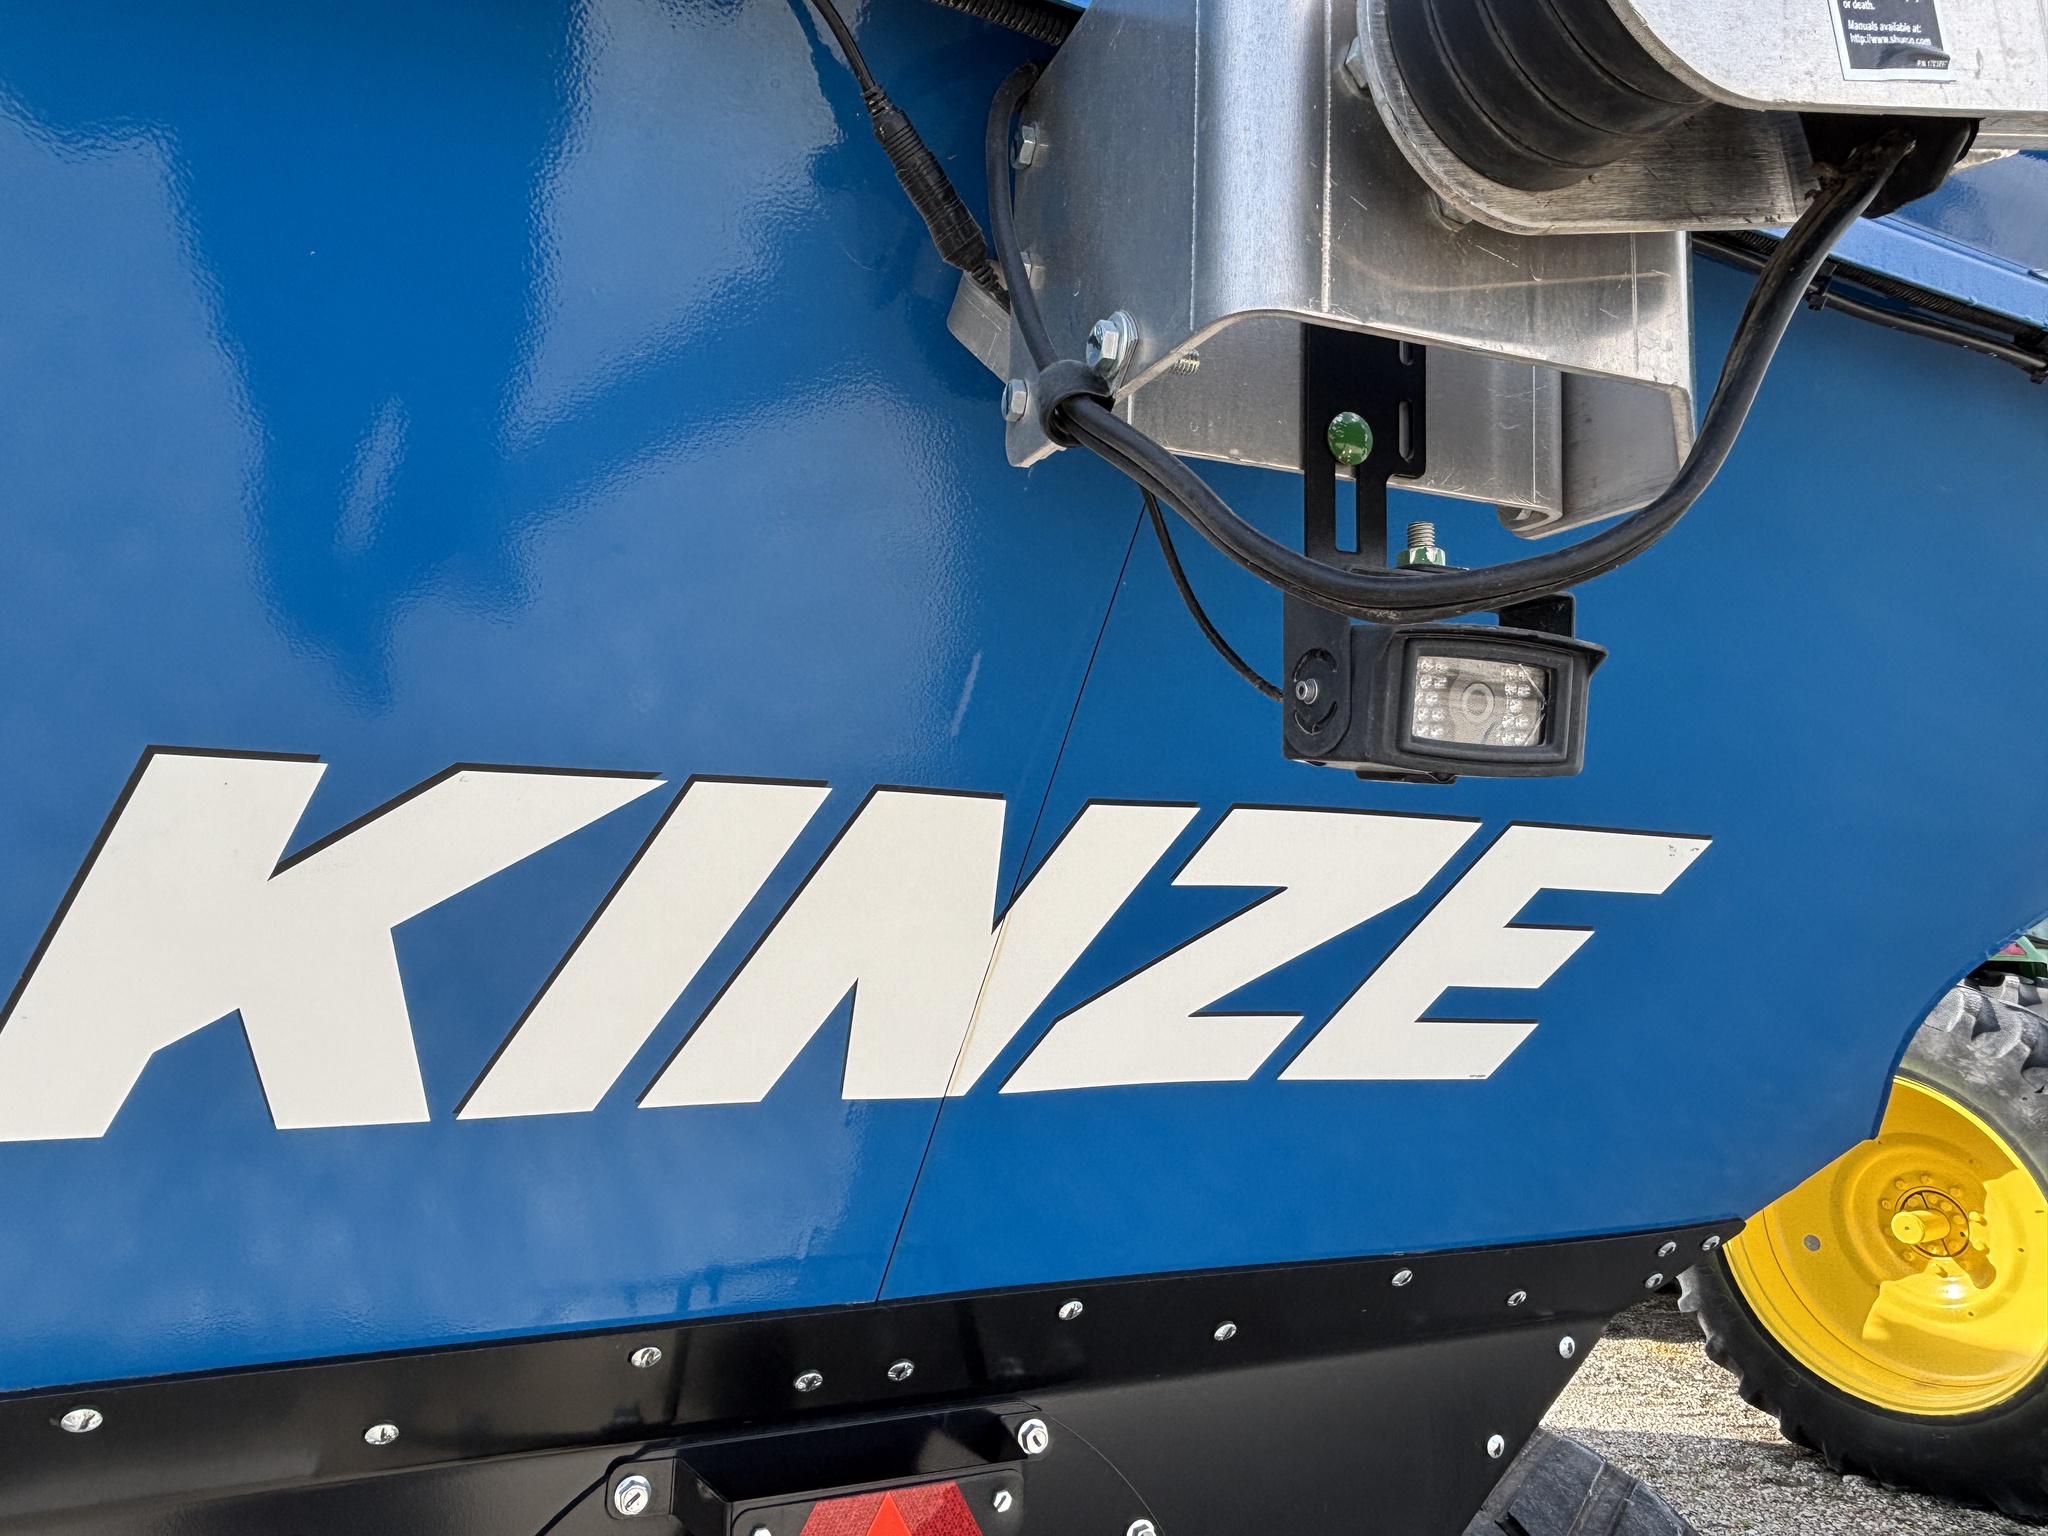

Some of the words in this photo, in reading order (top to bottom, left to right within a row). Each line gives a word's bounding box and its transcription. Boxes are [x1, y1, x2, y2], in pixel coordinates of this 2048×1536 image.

[1843, 0, 1851, 8] or
[1852, 0, 1875, 9] death.
[1848, 19, 1878, 31] Manuals
[1879, 21, 1911, 33] available
[1912, 24, 1922, 33] at:
[1850, 33, 1931, 46] http://www.shurco.com
[0, 746, 1712, 1141] KINZE
